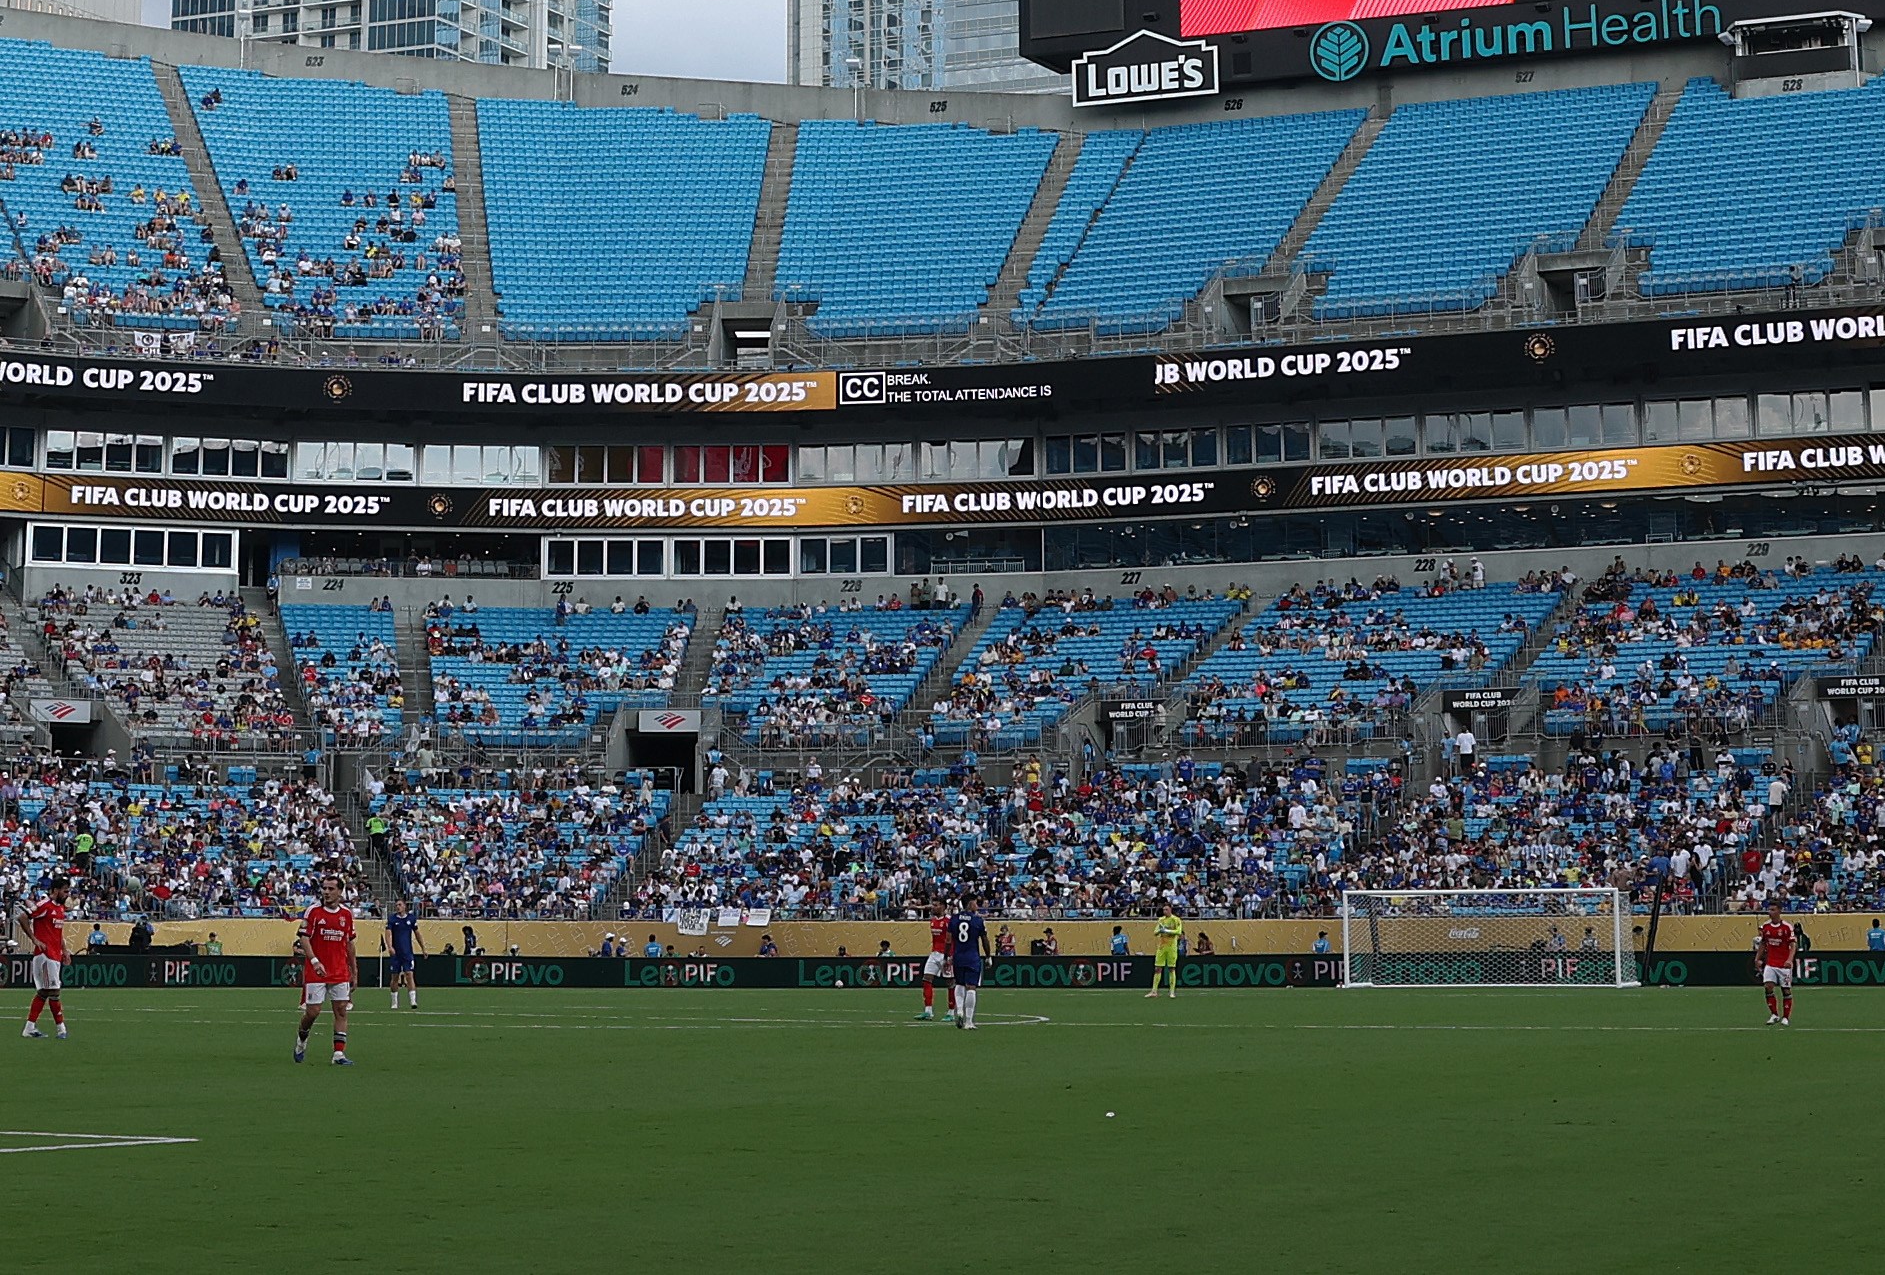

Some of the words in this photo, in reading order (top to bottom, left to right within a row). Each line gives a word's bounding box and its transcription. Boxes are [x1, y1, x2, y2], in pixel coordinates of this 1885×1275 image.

[1381, 18, 1554, 71] Atrium
[1087, 53, 1204, 98] LOWE'S
[1224, 99, 1243, 111] 526
[1671, 326, 1730, 350] FIFA
[1734, 321, 1804, 346] CLUB
[1184, 357, 1275, 382] WORLD
[1280, 353, 1331, 376] CUP
[82, 367, 134, 389] CUP
[886, 373, 931, 387] BREAK.
[463, 382, 517, 403] FIFA
[521, 383, 586, 404] CLUB
[591, 383, 683, 403] WORLD
[688, 382, 739, 403] CUP
[845, 378, 880, 399] CC
[887, 391, 911, 404] THE
[915, 390, 953, 403] TOTAL
[955, 386, 1037, 401] ATTENDANCE
[1040, 385, 1052, 398] IS
[1743, 450, 1796, 472] FIFA
[1800, 446, 1864, 468] CLUB
[1311, 474, 1360, 496] FIFA
[1363, 471, 1422, 492] CLUB
[1426, 466, 1512, 489] WORLD
[1516, 463, 1564, 484] CUP
[71, 485, 120, 506] FIFA
[124, 487, 183, 508] CLUB
[187, 490, 270, 511] WORLD
[274, 494, 320, 513] CUP
[489, 498, 537, 517] FIFA
[541, 498, 599, 517] CLUB
[603, 498, 686, 517] WORLD
[690, 498, 736, 517] CUP
[902, 494, 950, 513] FIFA
[953, 492, 1011, 512] CLUB
[1015, 488, 1099, 510] WORLD
[1102, 486, 1146, 506] CUP
[1746, 543, 1770, 557] 229
[1413, 559, 1436, 573] 228
[119, 572, 142, 586] 323
[322, 579, 344, 592] 224
[551, 581, 574, 595] 225
[1121, 571, 1142, 586] 227
[1827, 688, 1857, 696] WORLD
[1857, 686, 1874, 695] CUP
[1840, 678, 1858, 687] FIFA
[1858, 677, 1880, 686] CLUB
[1452, 700, 1480, 708] WORLD
[1482, 691, 1501, 699] CLUB
[958, 922, 969, 943] 8
[165, 961, 191, 983] PIF
[491, 962, 523, 981] PIF
[685, 964, 718, 982] PIF
[887, 963, 921, 982] PIF
[1097, 962, 1133, 981] PIF
[1795, 958, 1818, 979] IF
